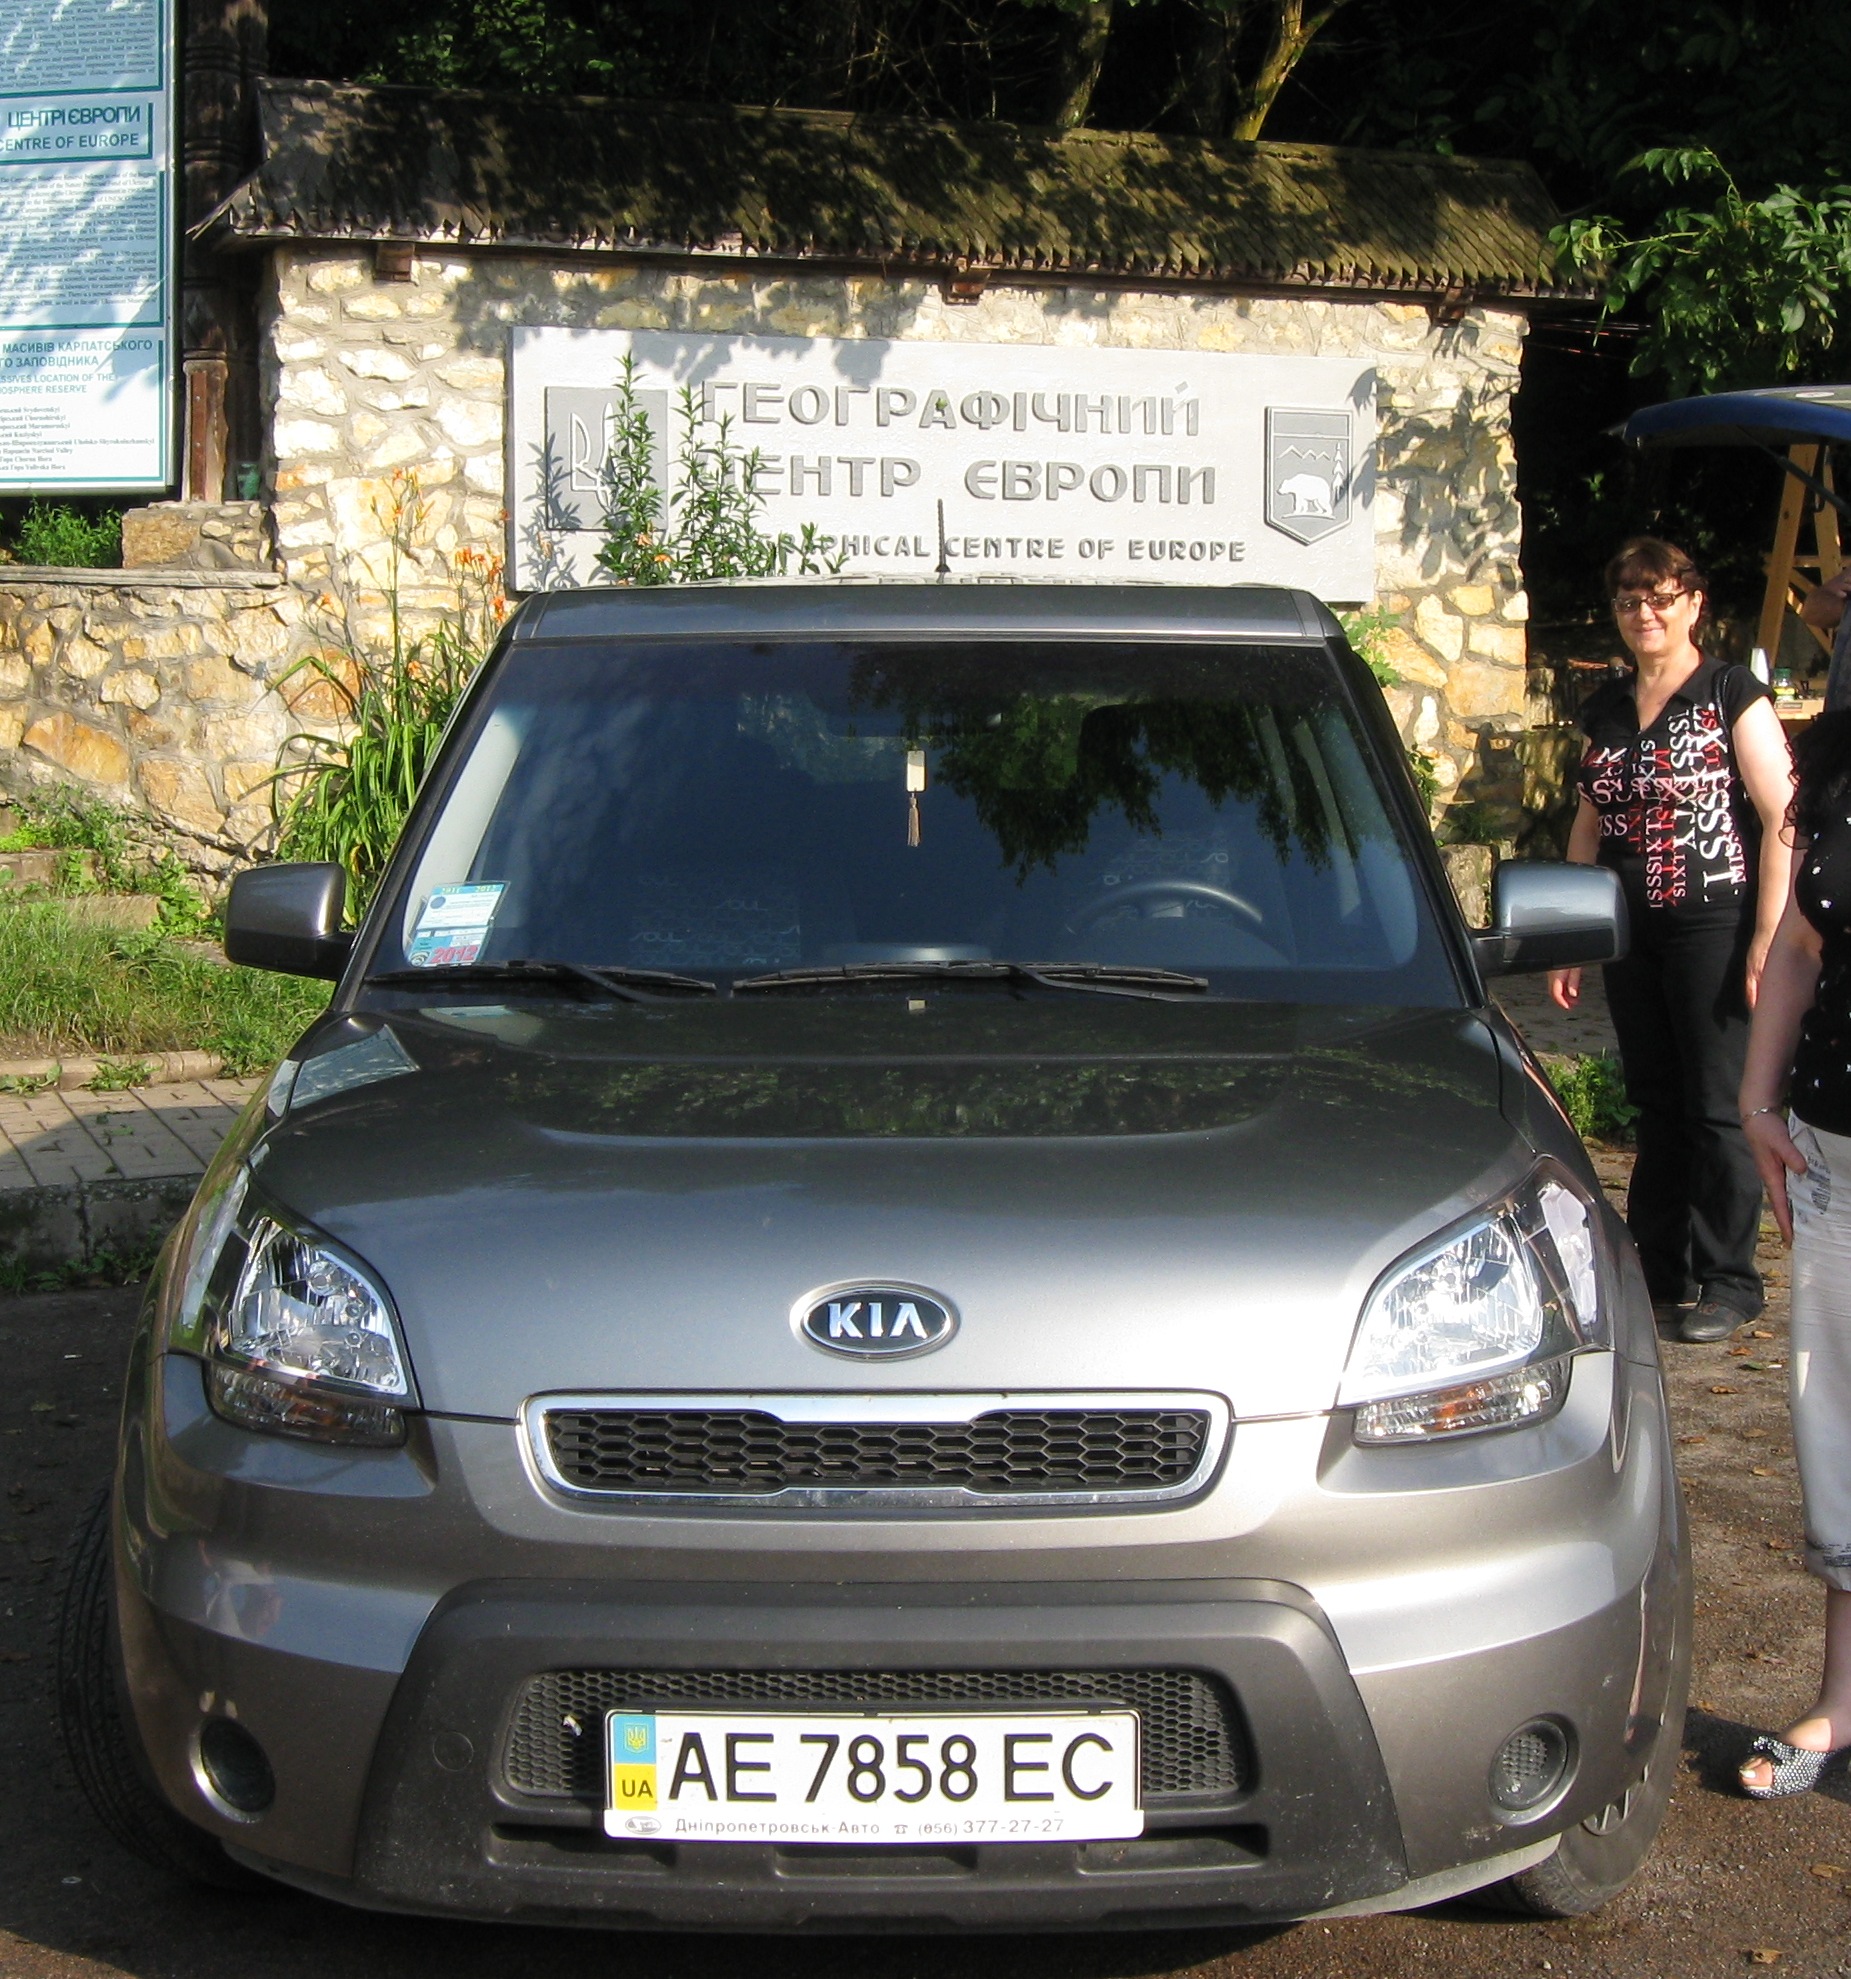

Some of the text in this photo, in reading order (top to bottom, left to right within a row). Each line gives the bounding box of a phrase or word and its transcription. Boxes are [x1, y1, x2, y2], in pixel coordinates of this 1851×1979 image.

[68, 106, 141, 125] ЄВРОПИ
[55, 135, 75, 149] OF
[78, 133, 140, 148] EUROPE
[701, 380, 1200, 436] ГЕОГРАФІЧНИЙ
[964, 459, 1216, 505] ЄВРОПИ
[944, 535, 1066, 559] CENTRE
[1078, 536, 1116, 560] OF
[1128, 538, 1247, 562] EUROPE
[431, 945, 479, 963] 2012
[827, 1301, 929, 1341] KIA
[668, 1732, 1114, 1804] AE 7858 EC
[622, 1779, 654, 1798] UA
[918, 1823, 959, 1835] (056)
[963, 1818, 1065, 1834] 377-27-27
